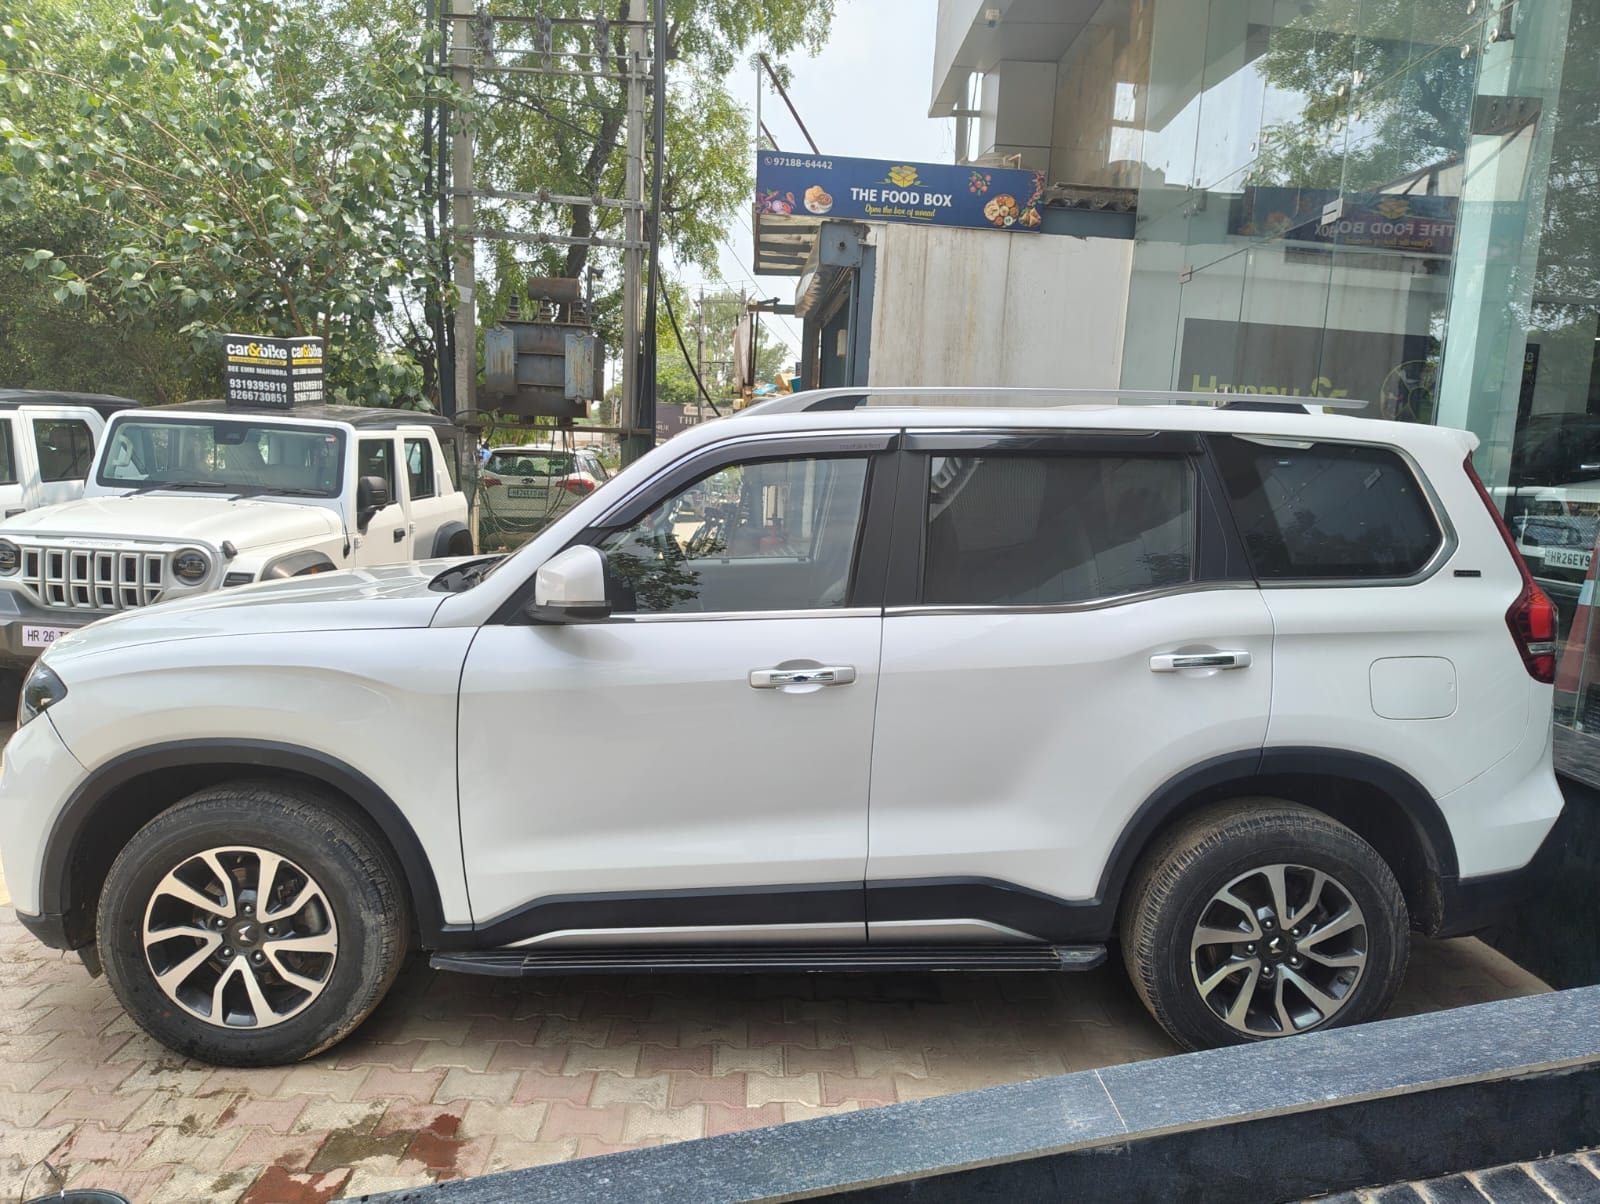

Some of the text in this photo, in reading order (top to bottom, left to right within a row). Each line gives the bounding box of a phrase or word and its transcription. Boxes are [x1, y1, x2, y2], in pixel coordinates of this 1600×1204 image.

[774, 157, 833, 170] 97188-64442
[850, 188, 953, 207] THE FOOD BOX
[226, 342, 288, 360] car&bike
[256, 368, 288, 376] MAHINDRA
[229, 378, 287, 393] 9319395919
[230, 389, 287, 403] 9266730851
[27, 630, 40, 641] HR
[43, 630, 55, 642] 26
